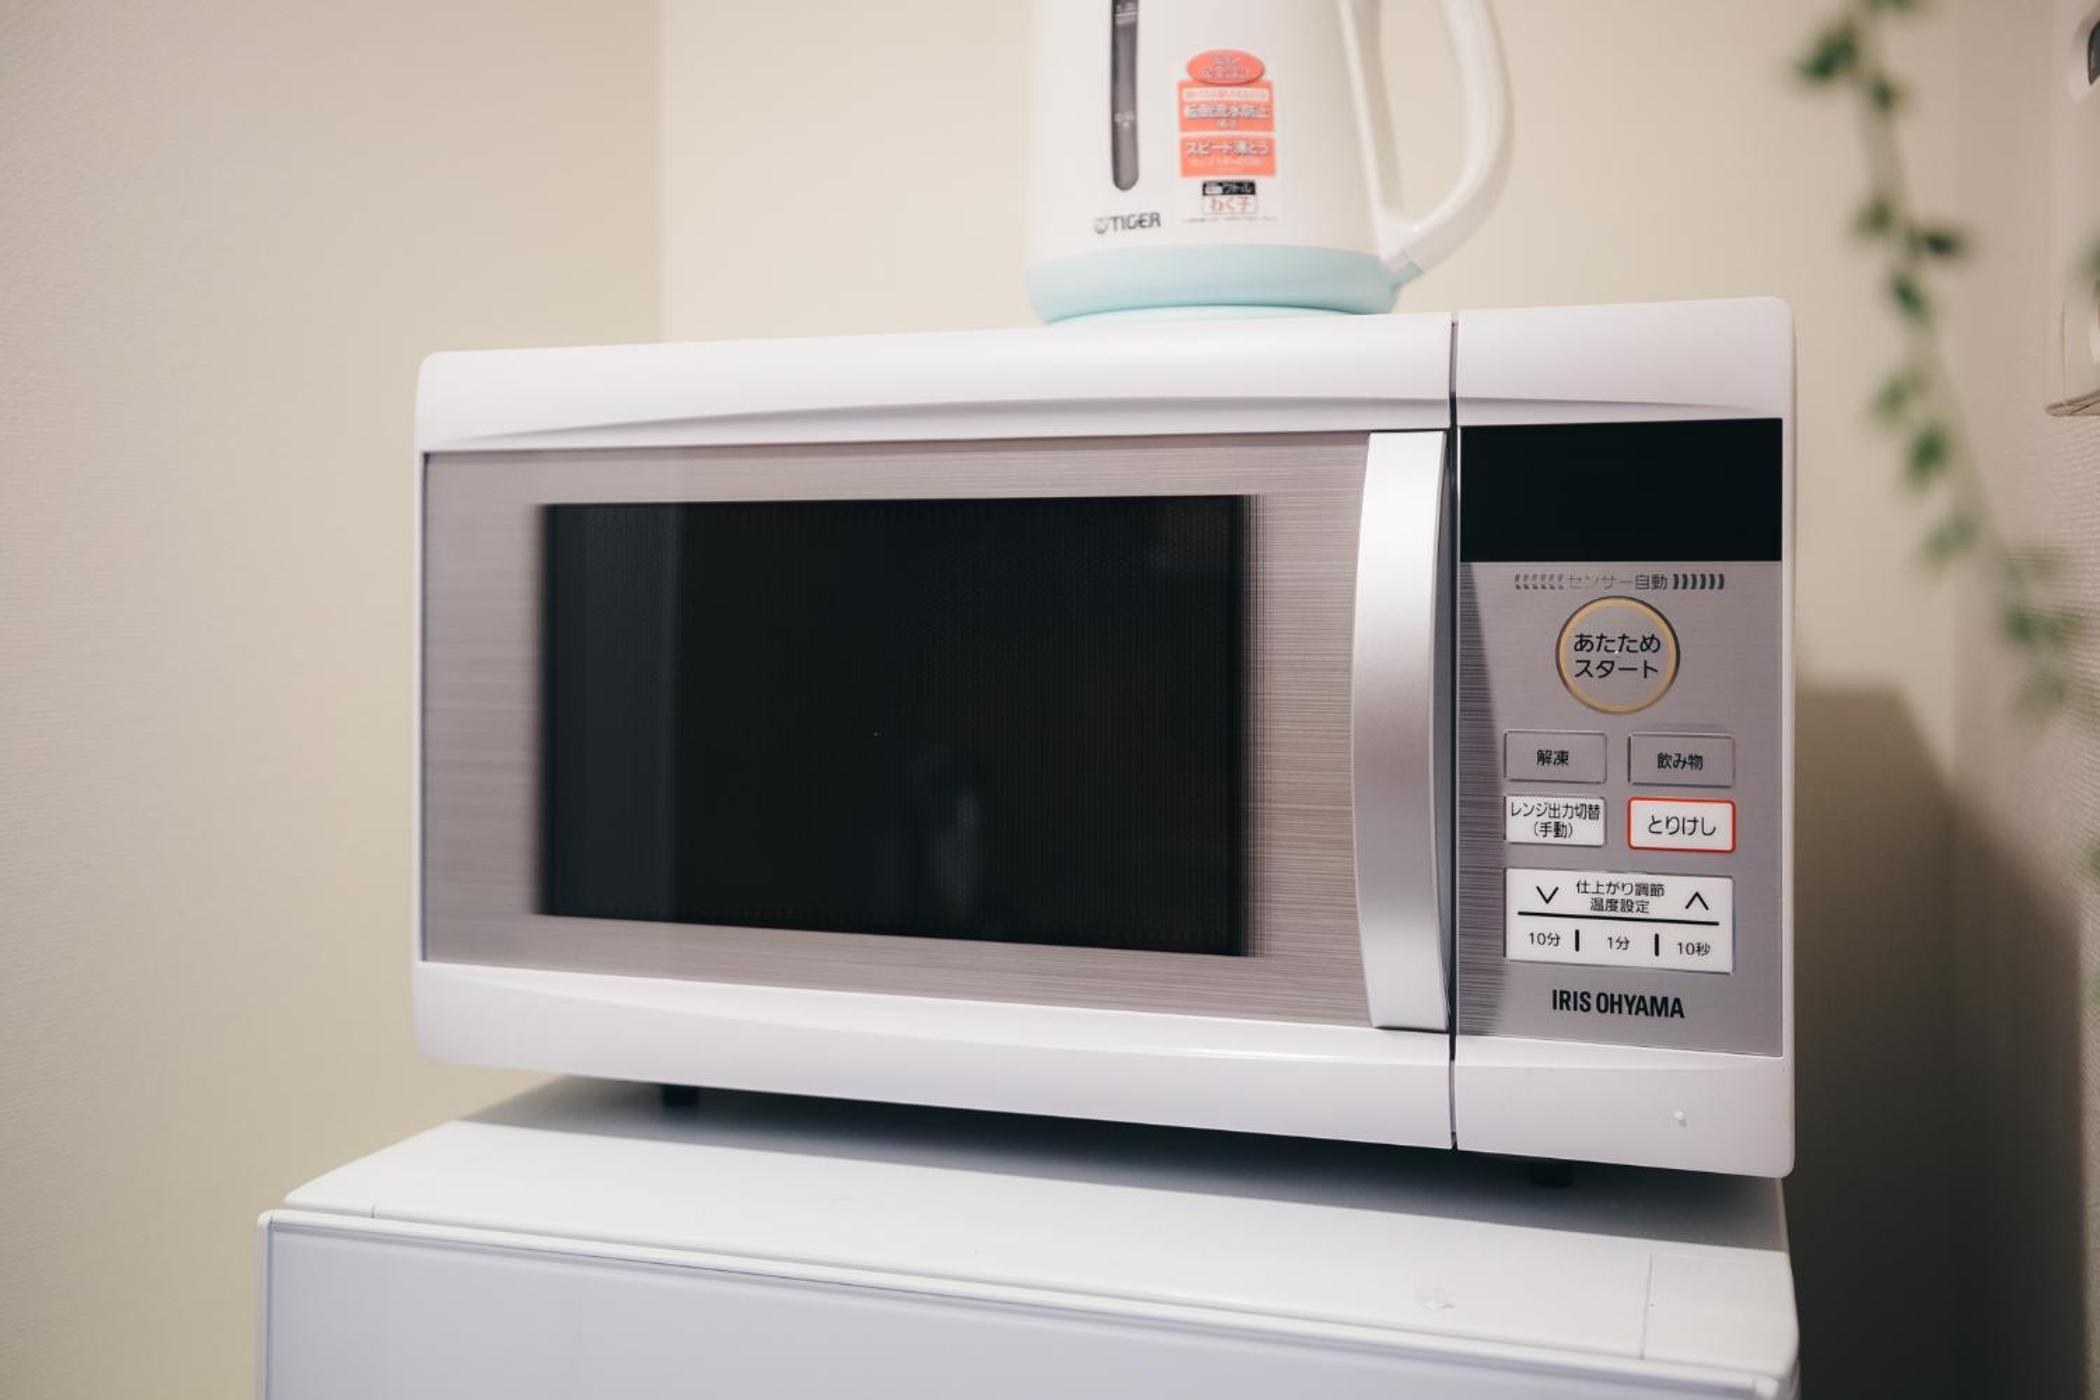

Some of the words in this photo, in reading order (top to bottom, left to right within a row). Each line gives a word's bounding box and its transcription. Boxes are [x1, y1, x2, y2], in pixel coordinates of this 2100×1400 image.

[1109, 212, 1162, 231] TIGER
[1567, 573, 1668, 591] センサー自動
[1573, 632, 1661, 654] あたため
[1574, 659, 1659, 679] スタート
[1536, 749, 1569, 767] 解凍
[1656, 751, 1704, 771] 飲み物
[1510, 801, 1601, 821] レンジ出力切替
[1647, 814, 1717, 837] とりけし
[1576, 879, 1665, 898] 仕上がり調節
[1590, 897, 1650, 914] 温度設定
[1528, 931, 1562, 948] 10分
[1607, 935, 1630, 951] 1分
[1677, 941, 1711, 957] 10秒
[1552, 988, 1592, 1013] IRIS
[1595, 990, 1686, 1019] OHYAMA
